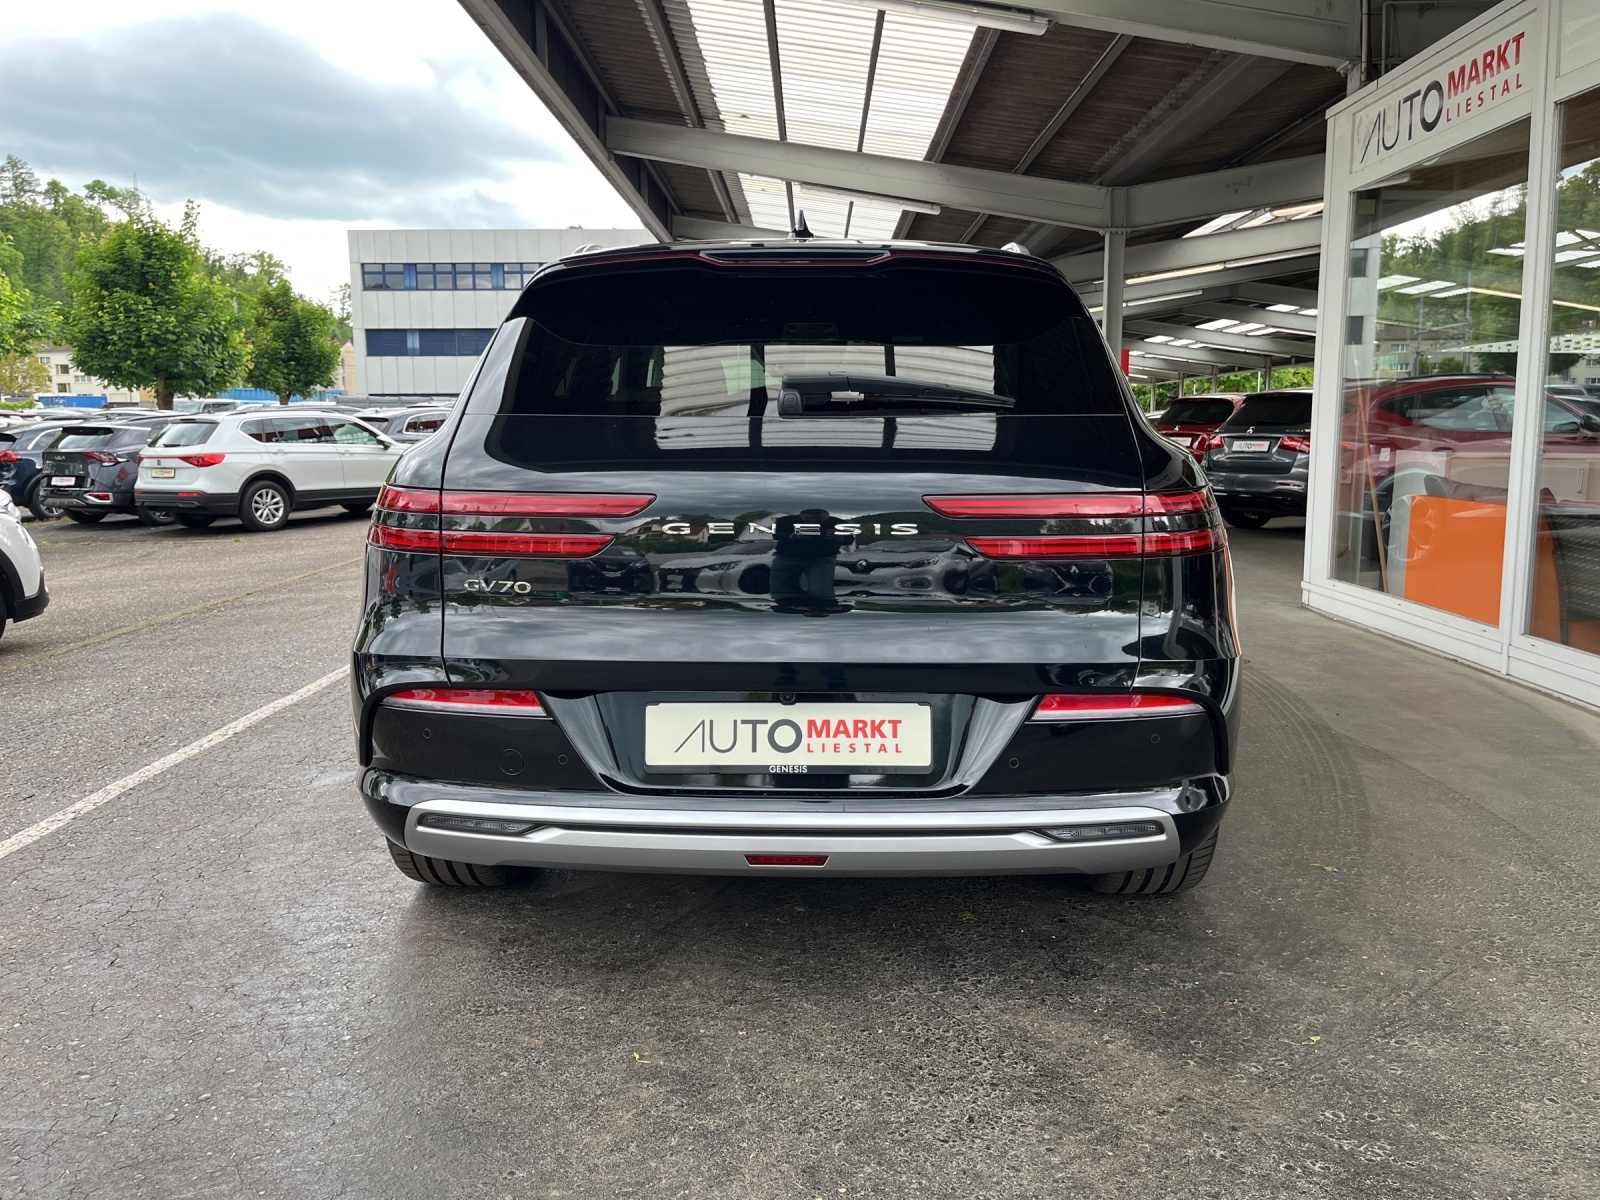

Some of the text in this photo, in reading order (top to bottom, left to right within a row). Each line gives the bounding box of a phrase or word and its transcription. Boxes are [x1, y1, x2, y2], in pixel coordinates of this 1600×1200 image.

[1360, 31, 1525, 164] AUTO MARKT
[1446, 73, 1523, 123] LIESTAL
[661, 522, 919, 536] GENESIS
[463, 579, 532, 594] GV70
[674, 718, 903, 754] AUTO MARKT
[806, 743, 903, 753] LIESTAL
[768, 765, 808, 773] GENESIS
